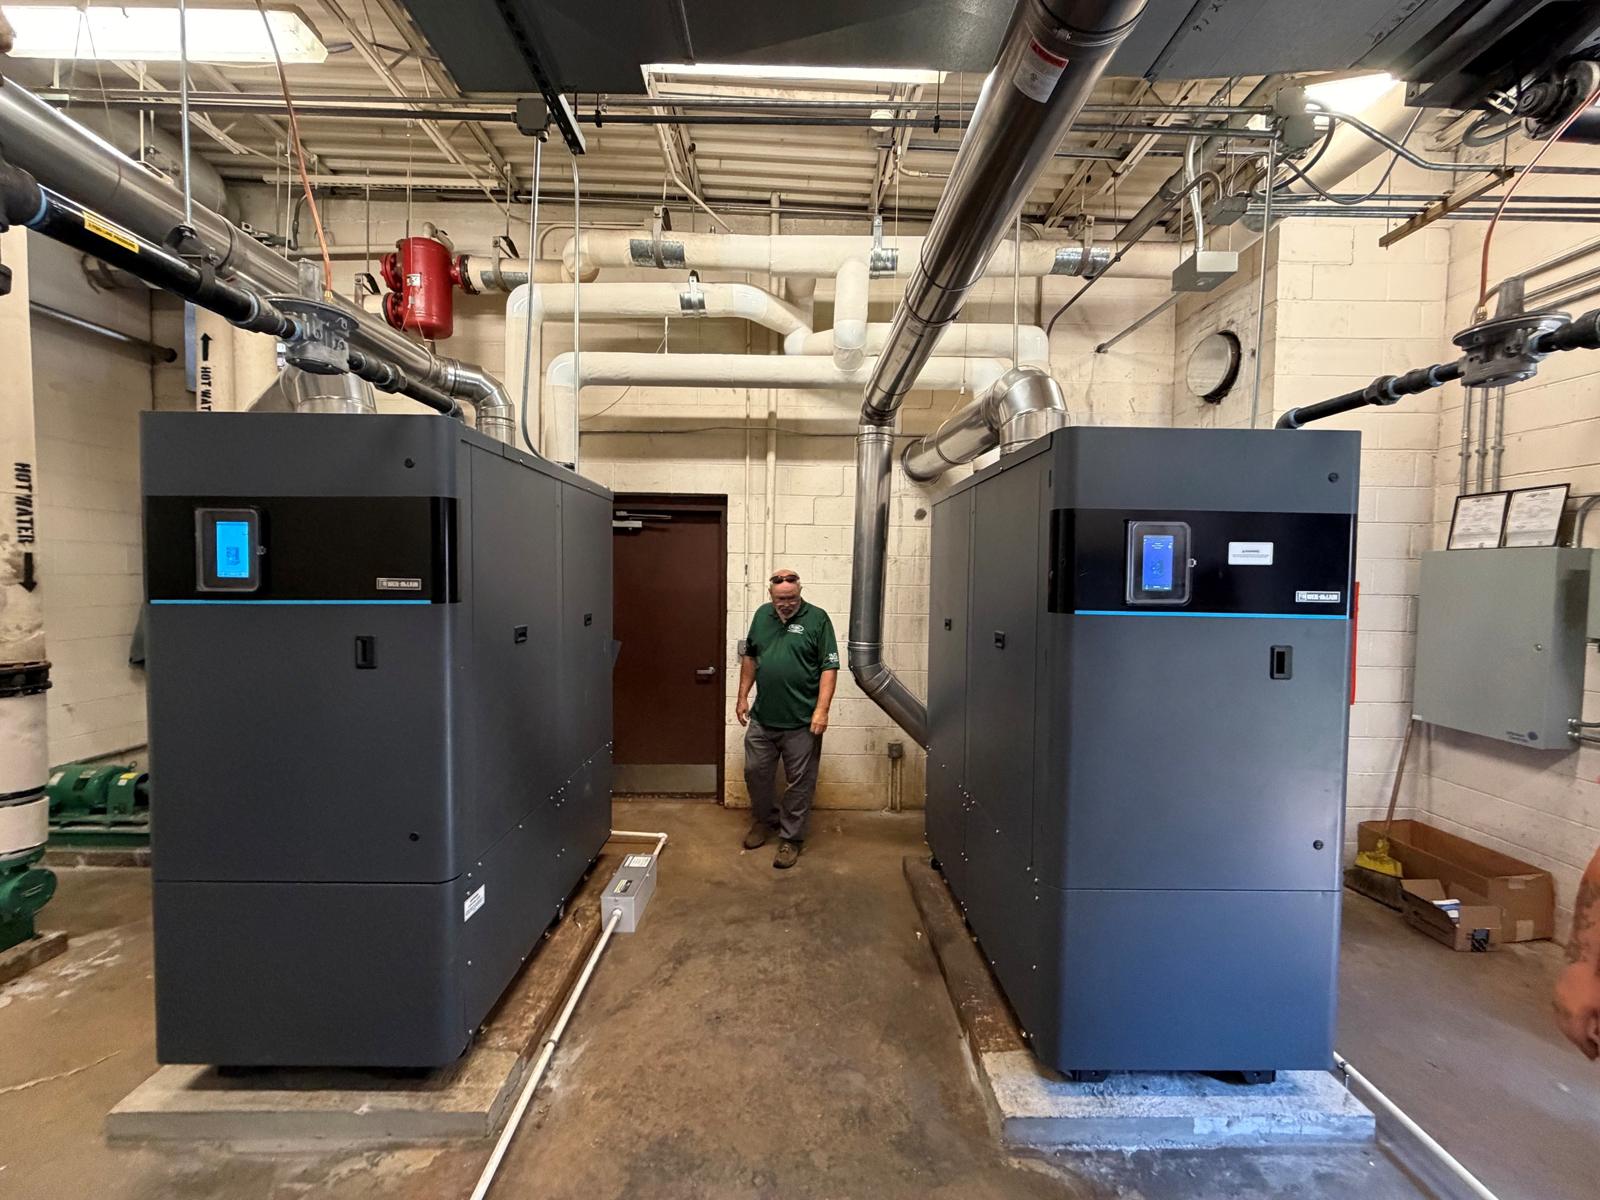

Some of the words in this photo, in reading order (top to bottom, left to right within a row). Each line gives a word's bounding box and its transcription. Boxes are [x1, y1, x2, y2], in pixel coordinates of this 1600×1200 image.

[200, 366, 212, 387] HOT
[200, 389, 212, 412] WAT
[14, 462, 33, 493] HOT
[14, 494, 35, 543] WATER
